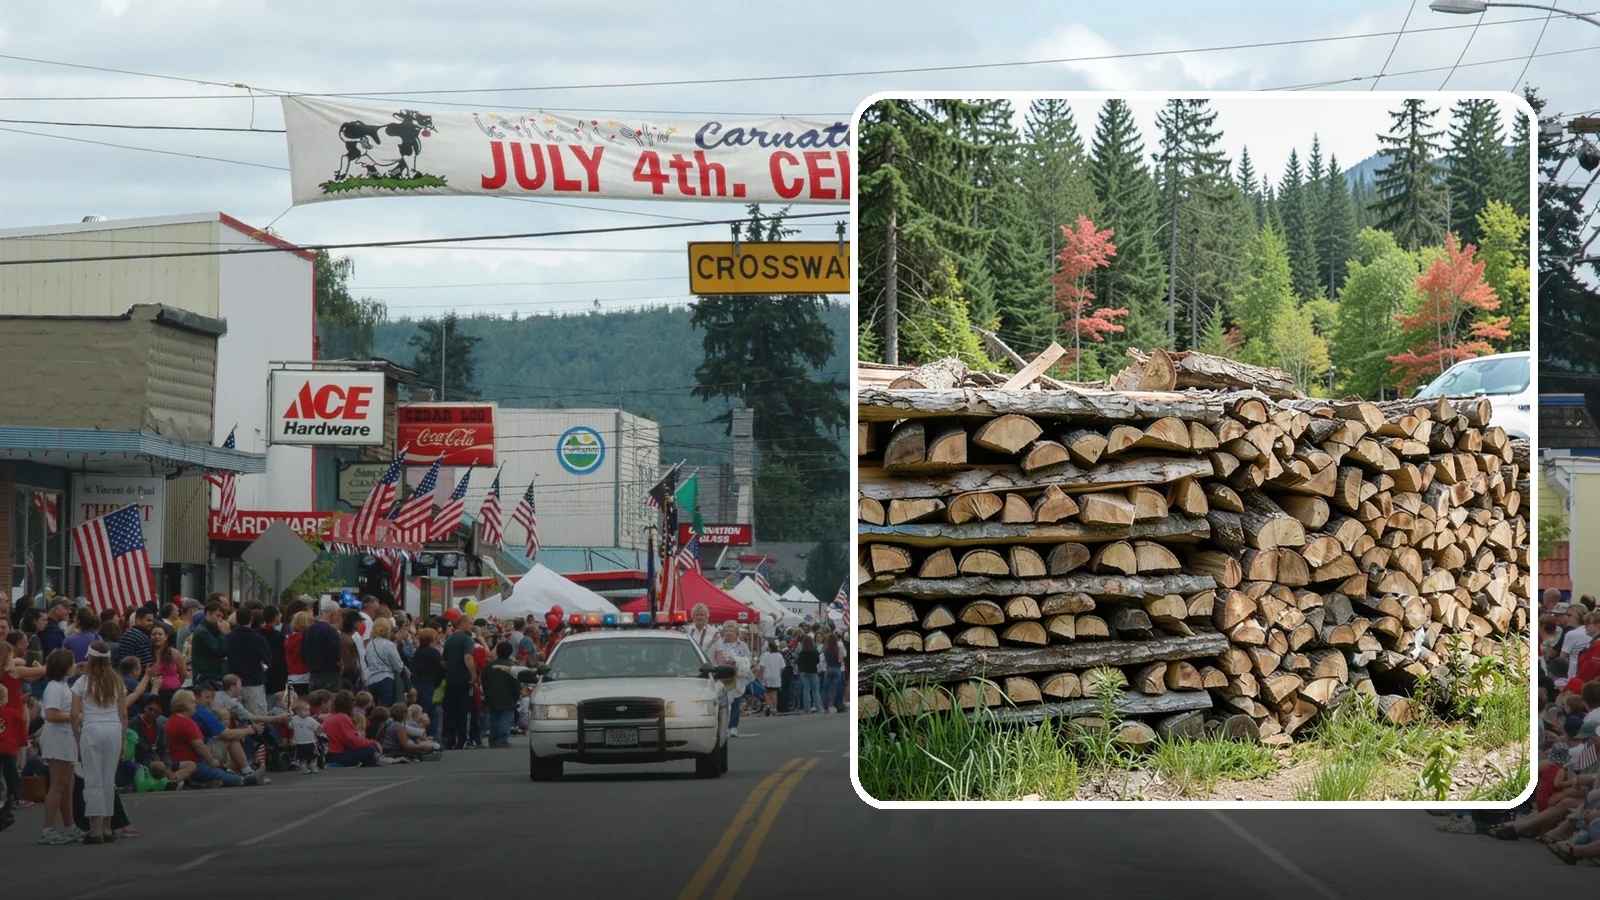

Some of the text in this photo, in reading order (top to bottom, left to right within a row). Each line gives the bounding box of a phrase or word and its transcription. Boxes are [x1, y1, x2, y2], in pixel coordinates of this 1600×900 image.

[481, 141, 605, 192] JULY
[632, 150, 746, 198] 4th.
[697, 254, 850, 280] CROSSWA
[283, 380, 374, 420] ACE
[405, 409, 452, 422] CEDAR
[283, 421, 371, 436] Hardware
[416, 428, 477, 447] Coca-Cola
[353, 467, 386, 480] Simpl
[83, 485, 155, 495] St. Vincent de Paul
[688, 526, 741, 535] CRNATION
[699, 535, 730, 543] GLASS
